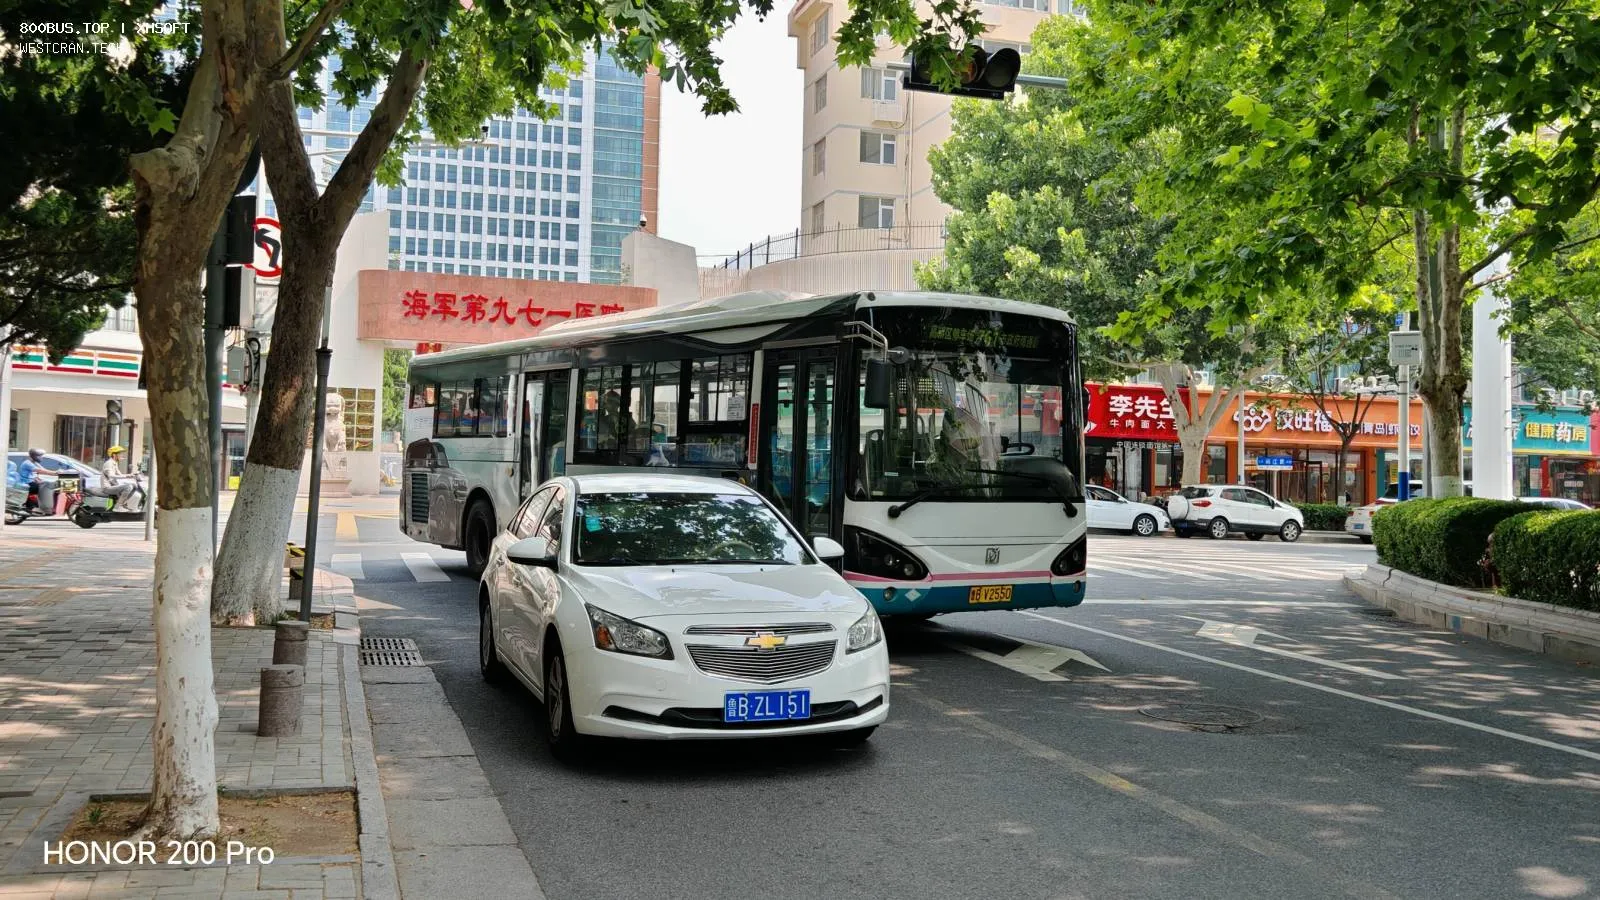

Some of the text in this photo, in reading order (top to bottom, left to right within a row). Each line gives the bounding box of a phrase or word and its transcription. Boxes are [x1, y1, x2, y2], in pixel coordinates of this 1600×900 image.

[1525, 421, 1587, 443] 健康药房
[1116, 441, 1184, 450] 中国连锁面馆第一品
